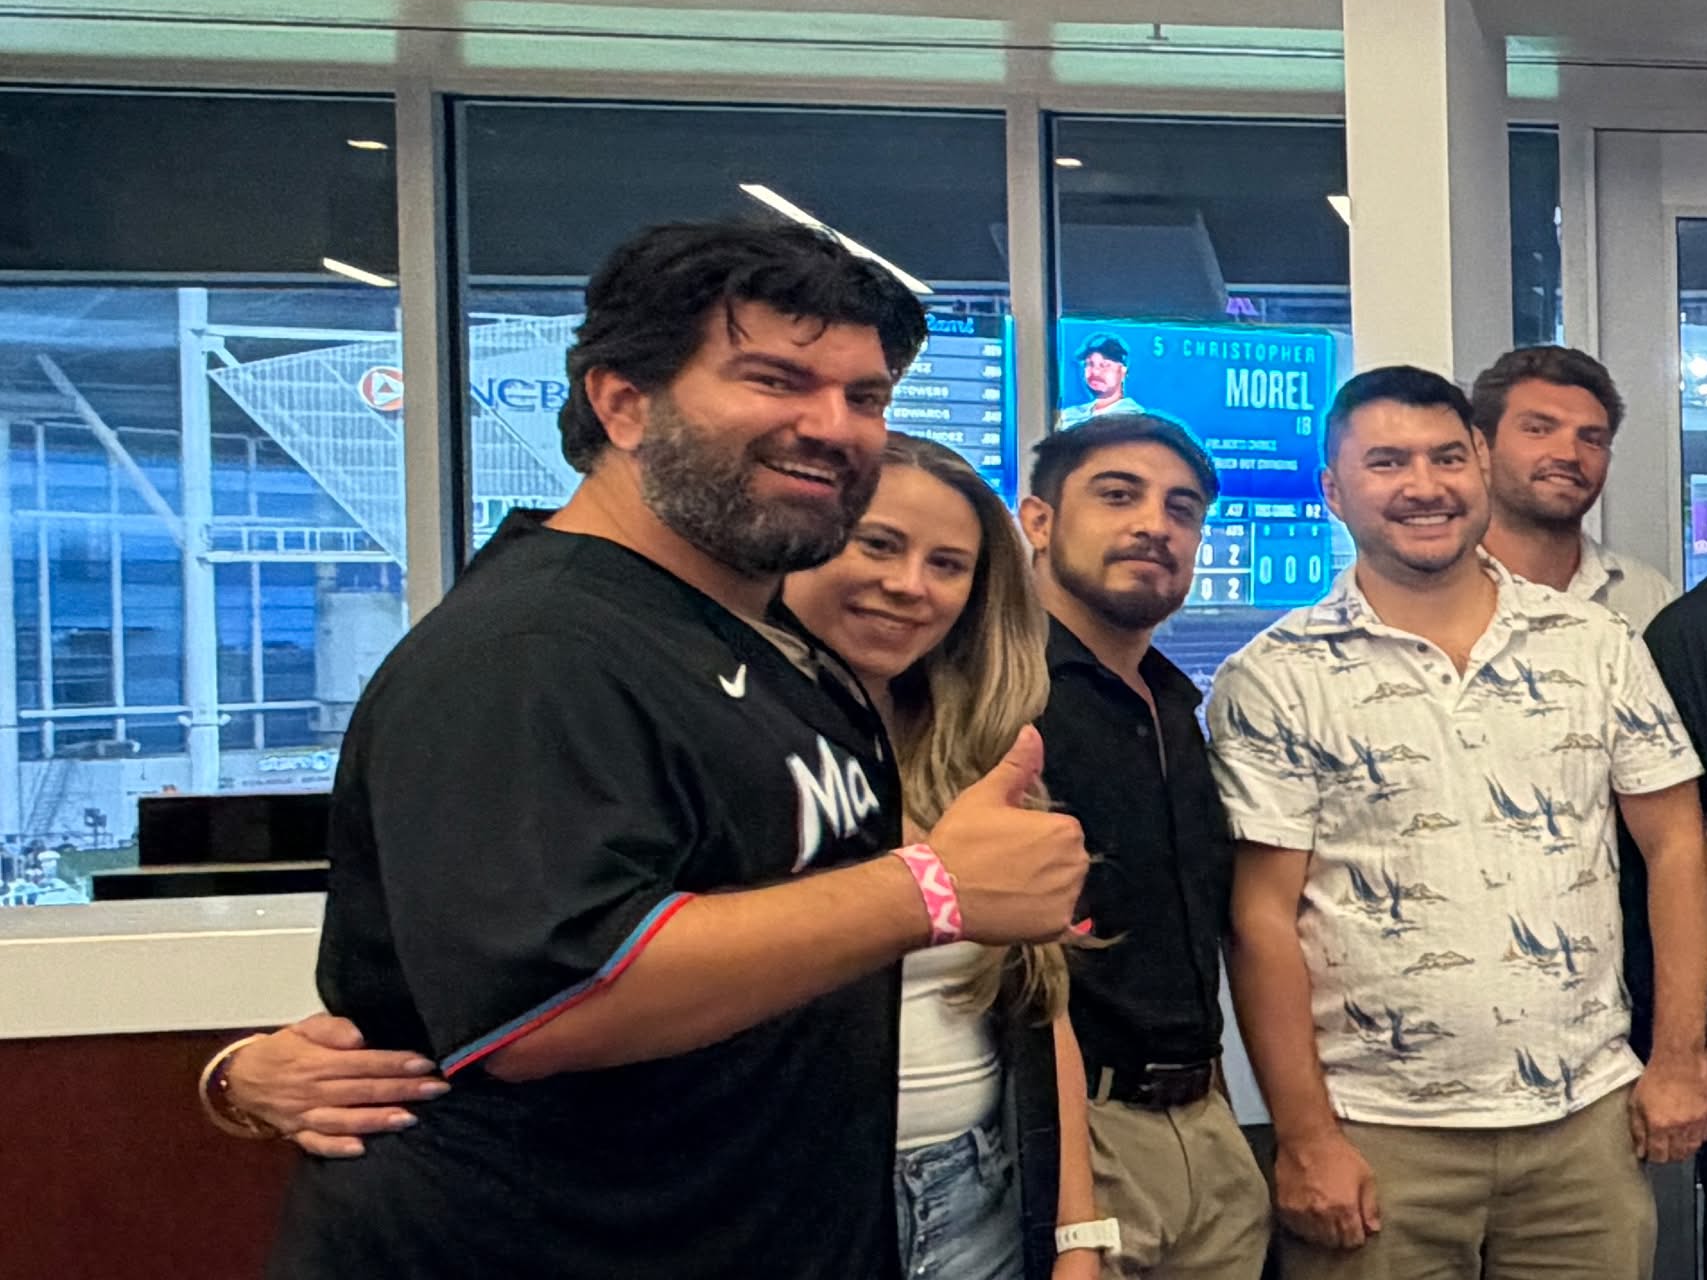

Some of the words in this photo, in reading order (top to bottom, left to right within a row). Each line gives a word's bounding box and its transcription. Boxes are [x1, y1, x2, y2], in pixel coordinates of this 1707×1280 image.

[1153, 336, 1164, 357] 5
[1183, 339, 1316, 364] CHRISTOPHER
[1226, 368, 1314, 411] MOREL
[1228, 543, 1240, 566] 2
[1260, 555, 1272, 584] 0
[1285, 555, 1296, 584] 0
[1309, 555, 1320, 584] 0
[1228, 577, 1240, 600] 2
[786, 733, 880, 873] Ma
